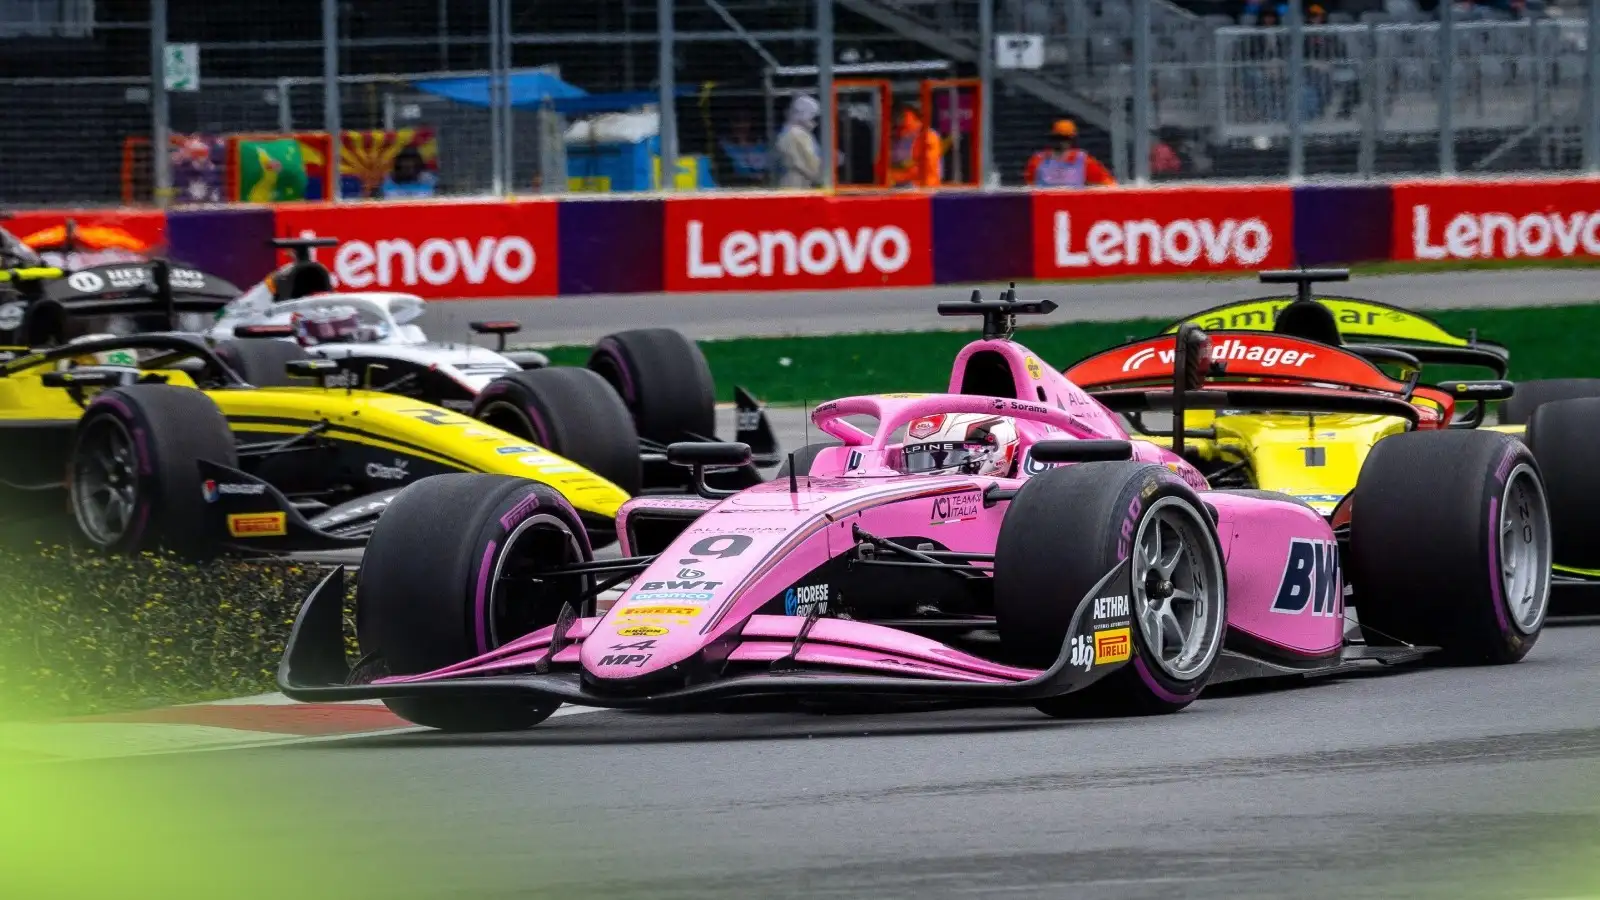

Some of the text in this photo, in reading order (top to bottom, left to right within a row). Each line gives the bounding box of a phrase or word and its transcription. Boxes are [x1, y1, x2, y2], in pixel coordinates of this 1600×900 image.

[686, 219, 911, 278] Lenovo
[1054, 210, 1272, 268] Lenovo
[1158, 340, 1316, 367] wdhager
[1011, 401, 1048, 414] Sorama
[951, 505, 978, 518] ITALIA
[1117, 495, 1142, 561] ERO
[680, 534, 754, 566] 9
[640, 581, 723, 591] BWT
[1270, 536, 1343, 618] BW
[635, 592, 709, 600] aramco
[797, 583, 829, 604] FIORESE
[1093, 594, 1130, 620] AETHRA
[1098, 635, 1128, 658] PIRELLI
